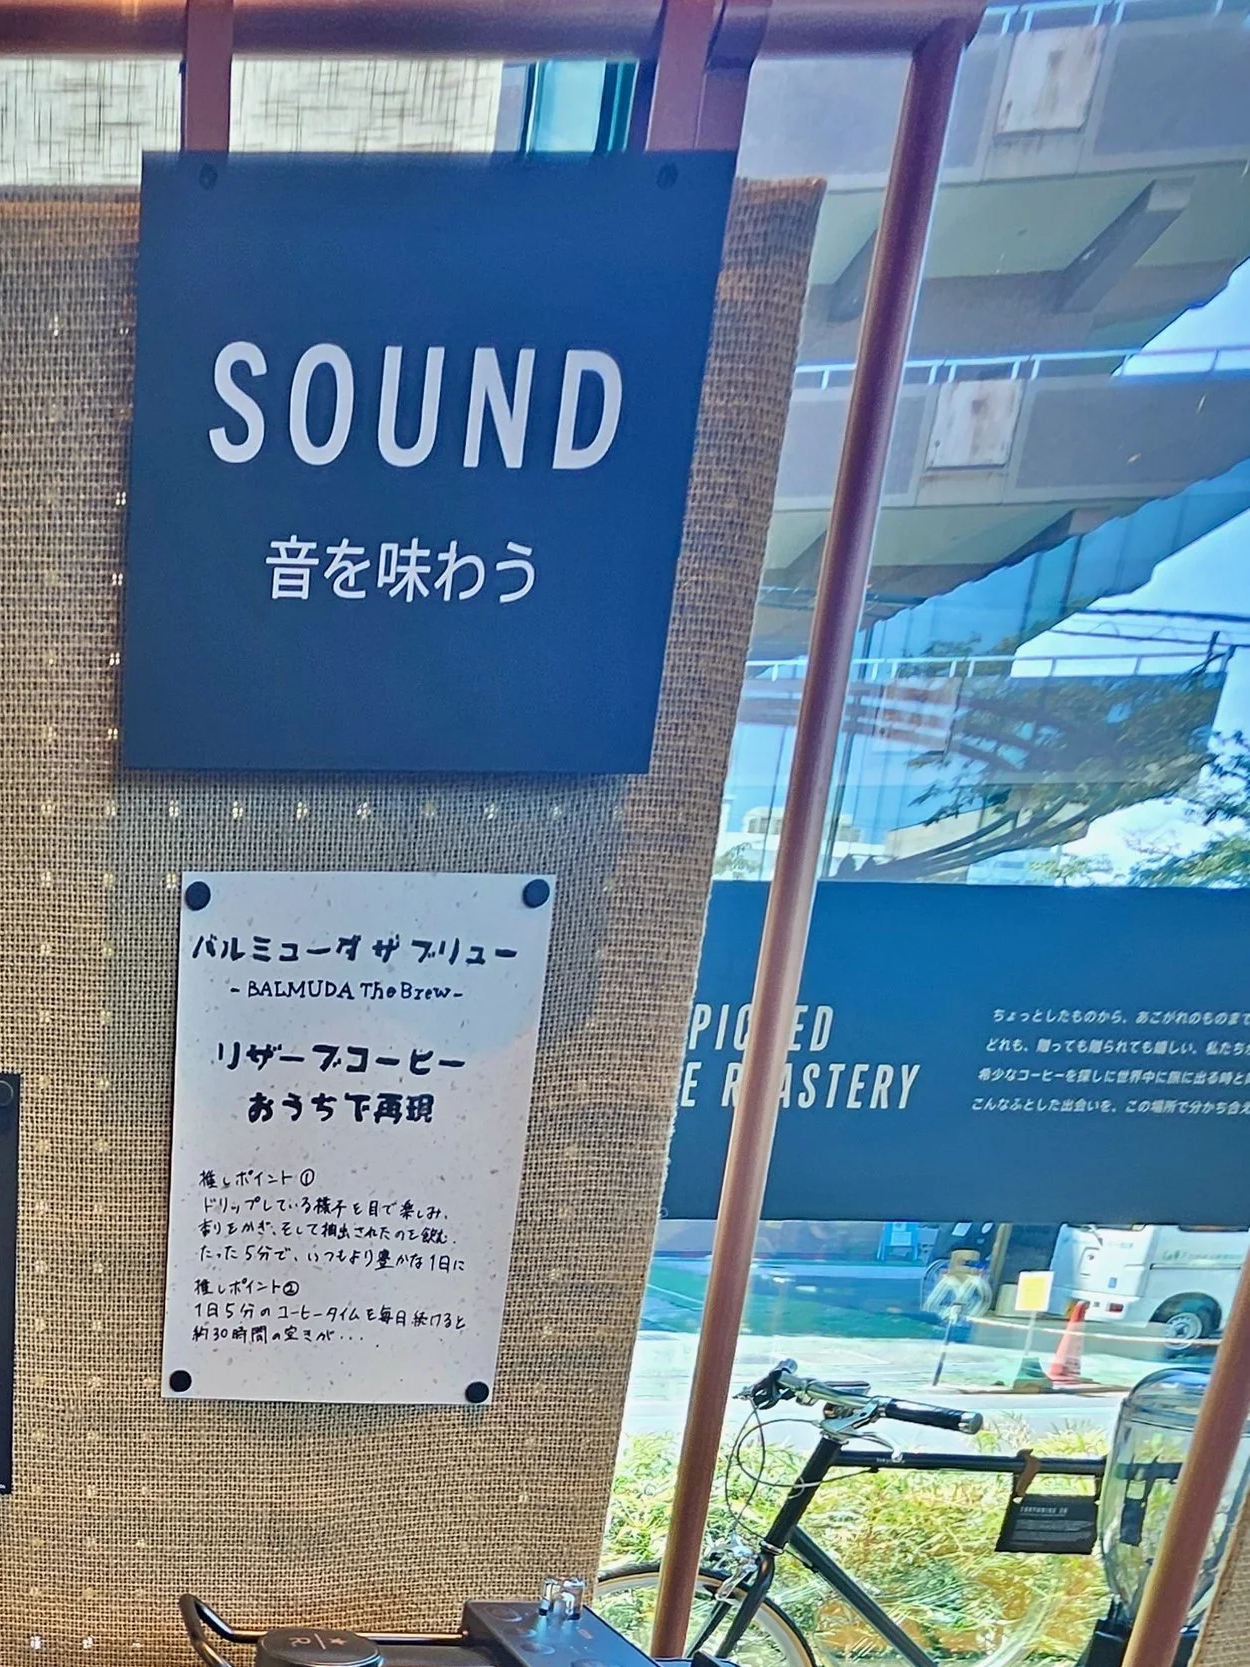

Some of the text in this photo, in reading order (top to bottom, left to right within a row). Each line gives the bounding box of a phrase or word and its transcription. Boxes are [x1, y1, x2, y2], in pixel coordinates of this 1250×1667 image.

[209, 341, 623, 471] SOUND
[266, 534, 537, 604] 音を味わう
[192, 934, 518, 966] バルミューダ ザ ブリュー
[248, 980, 355, 1000] BALMUDA
[360, 981, 397, 999] The
[688, 1003, 834, 1051] PICED
[217, 1042, 466, 1076] リザーブコーヒー
[721, 1062, 921, 1109] RASTERY
